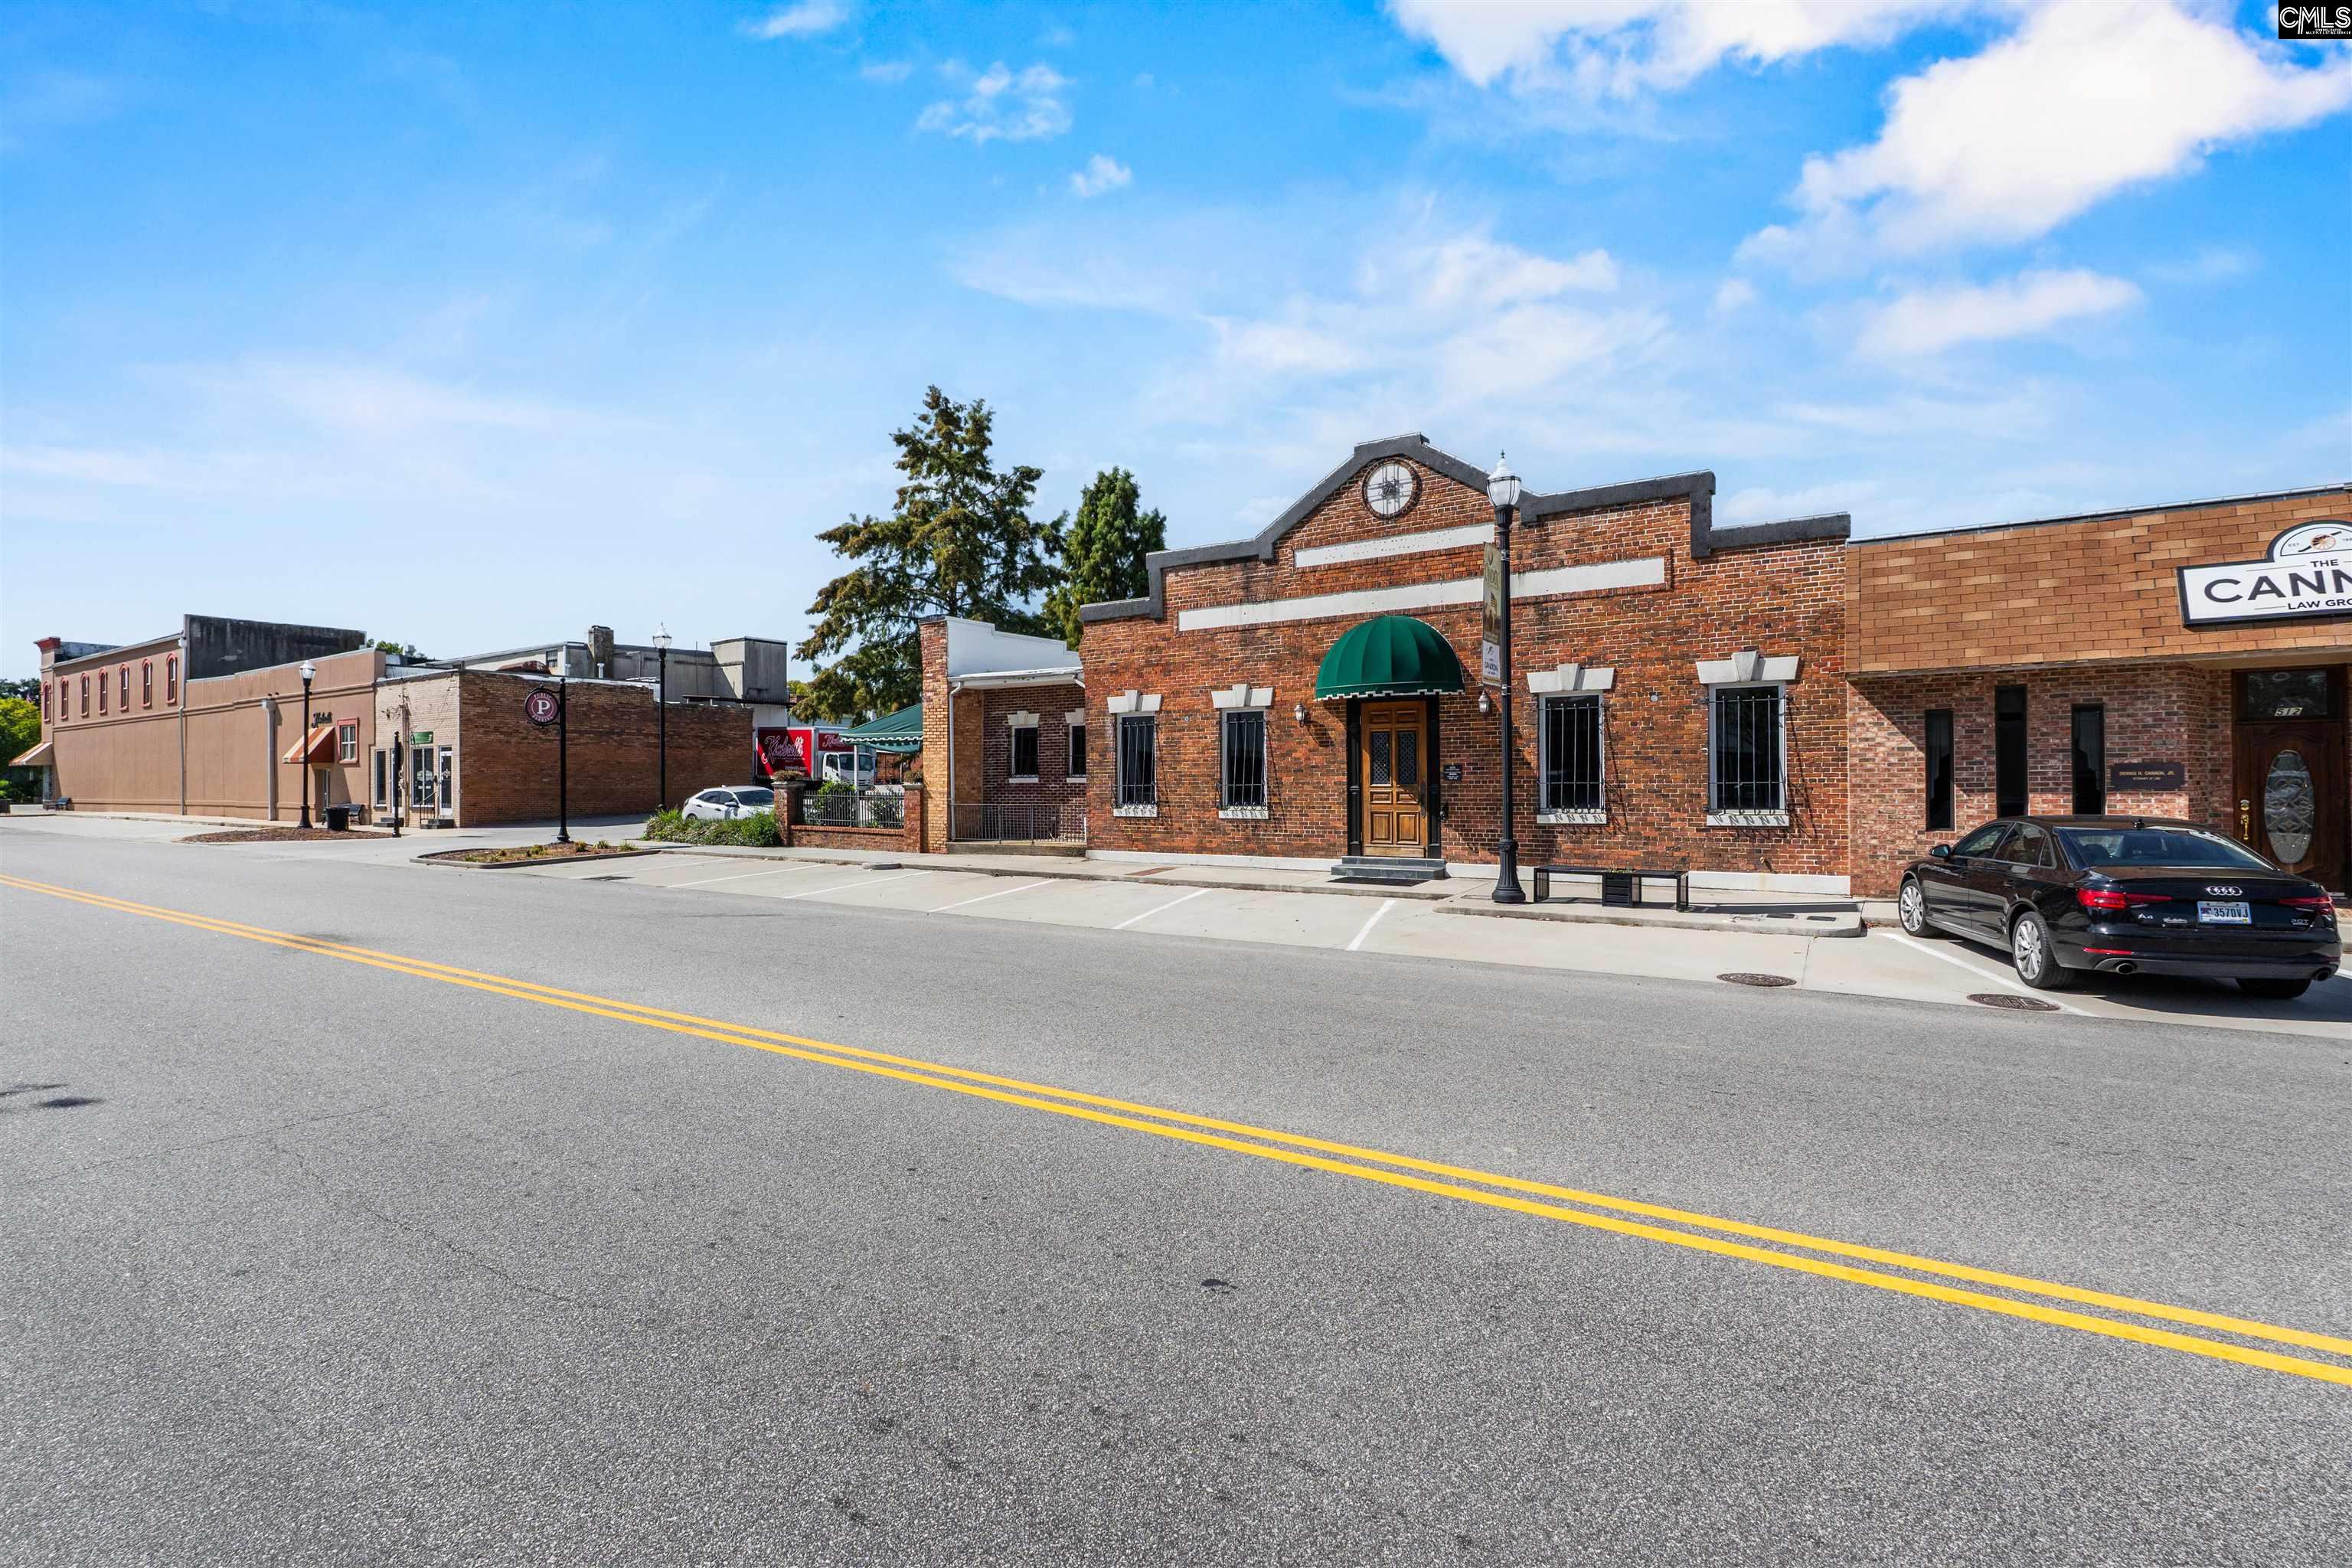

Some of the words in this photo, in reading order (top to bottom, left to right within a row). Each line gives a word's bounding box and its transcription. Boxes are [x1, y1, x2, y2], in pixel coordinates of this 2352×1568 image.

[2310, 559, 2339, 567] THE
[2204, 569, 2352, 603] CANN
[2288, 600, 2321, 610] LAW
[537, 699, 550, 714] P
[2275, 707, 2301, 717] 512
